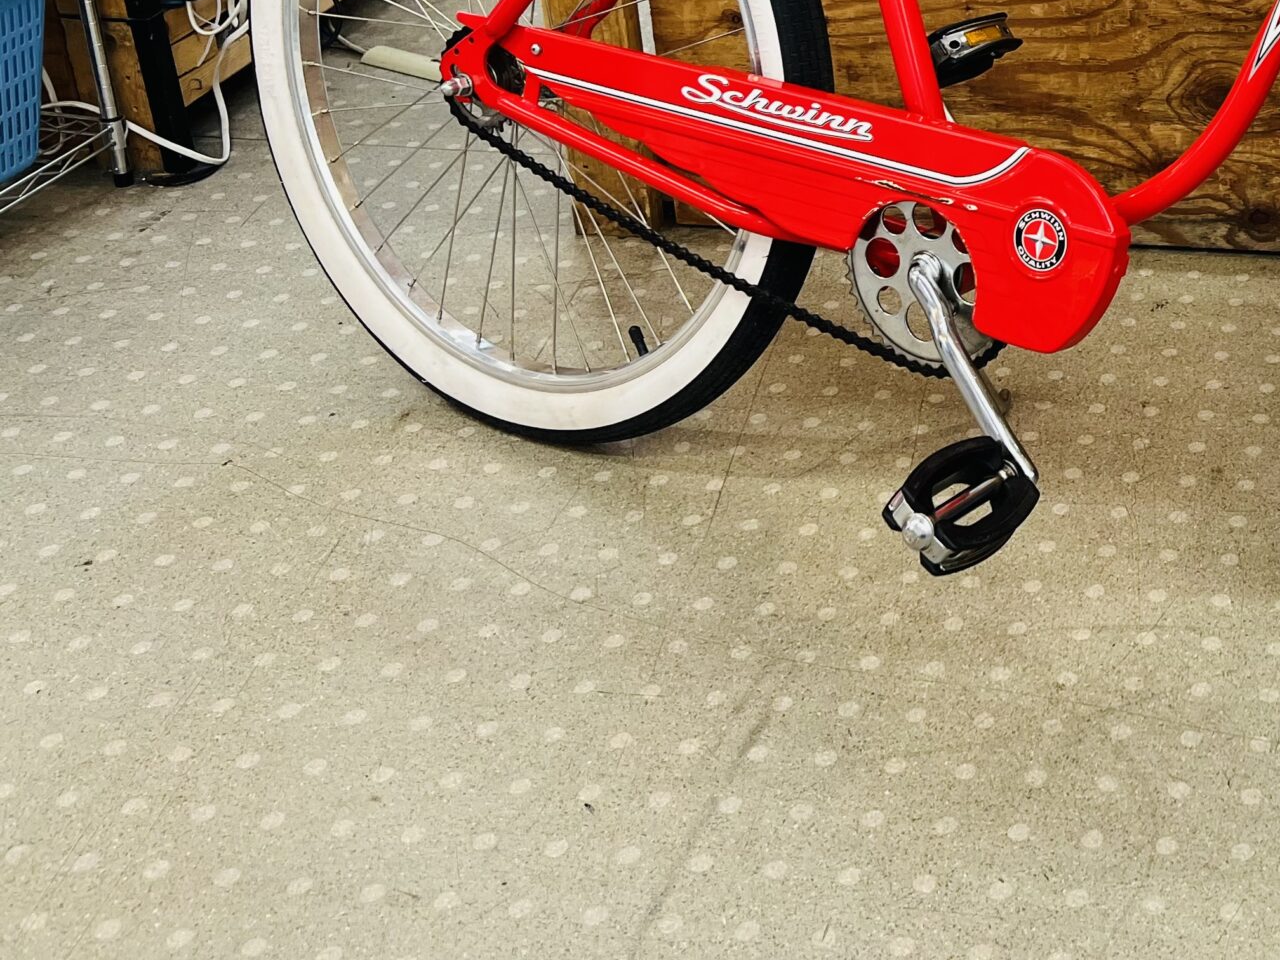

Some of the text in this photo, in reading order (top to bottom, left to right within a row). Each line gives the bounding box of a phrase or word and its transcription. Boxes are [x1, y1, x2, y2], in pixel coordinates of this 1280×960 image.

[680, 73, 874, 142] Schwinn
[1018, 210, 1064, 241] SCHWINN
[1018, 245, 1057, 268] QUALITY
